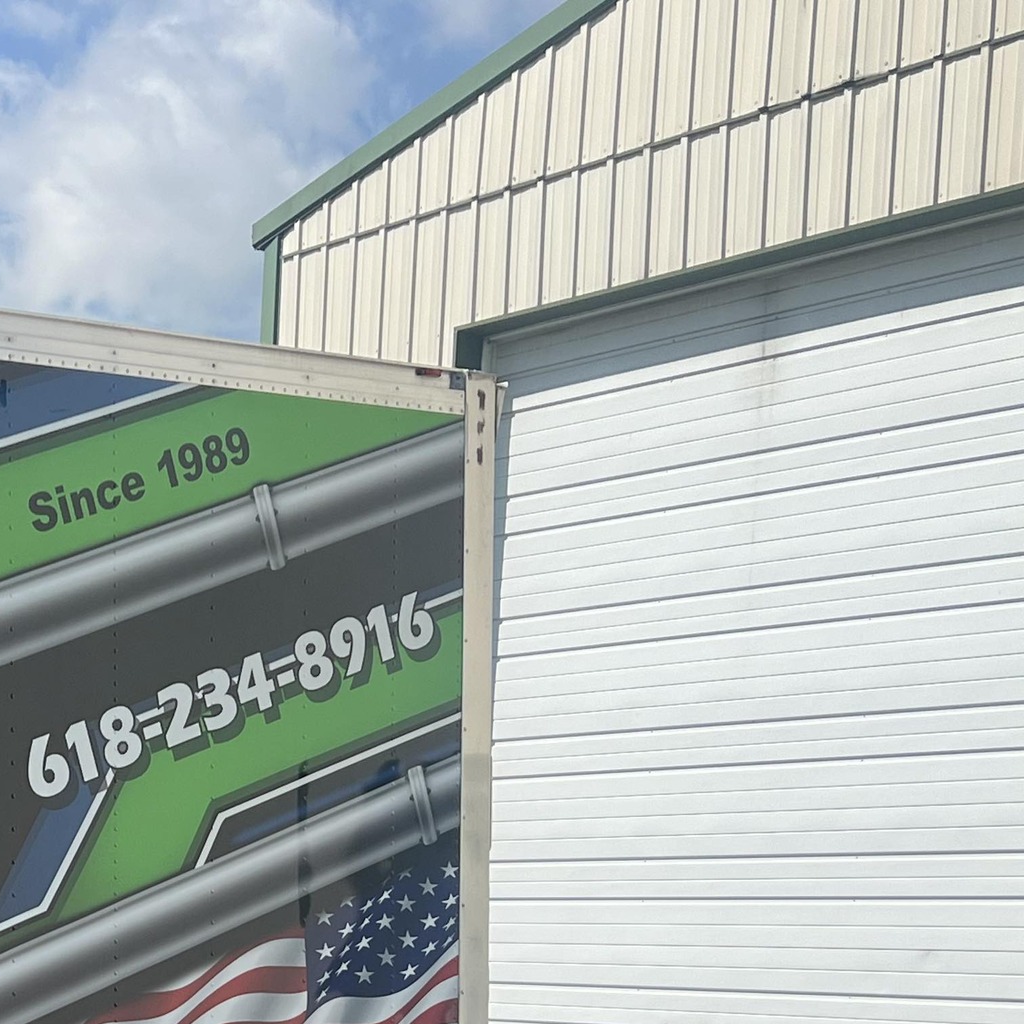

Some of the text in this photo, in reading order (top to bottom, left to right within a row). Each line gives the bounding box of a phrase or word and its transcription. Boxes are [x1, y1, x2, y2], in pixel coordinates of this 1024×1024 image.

[28, 426, 250, 533] Since 1989
[26, 591, 435, 798] 618-234-8916
